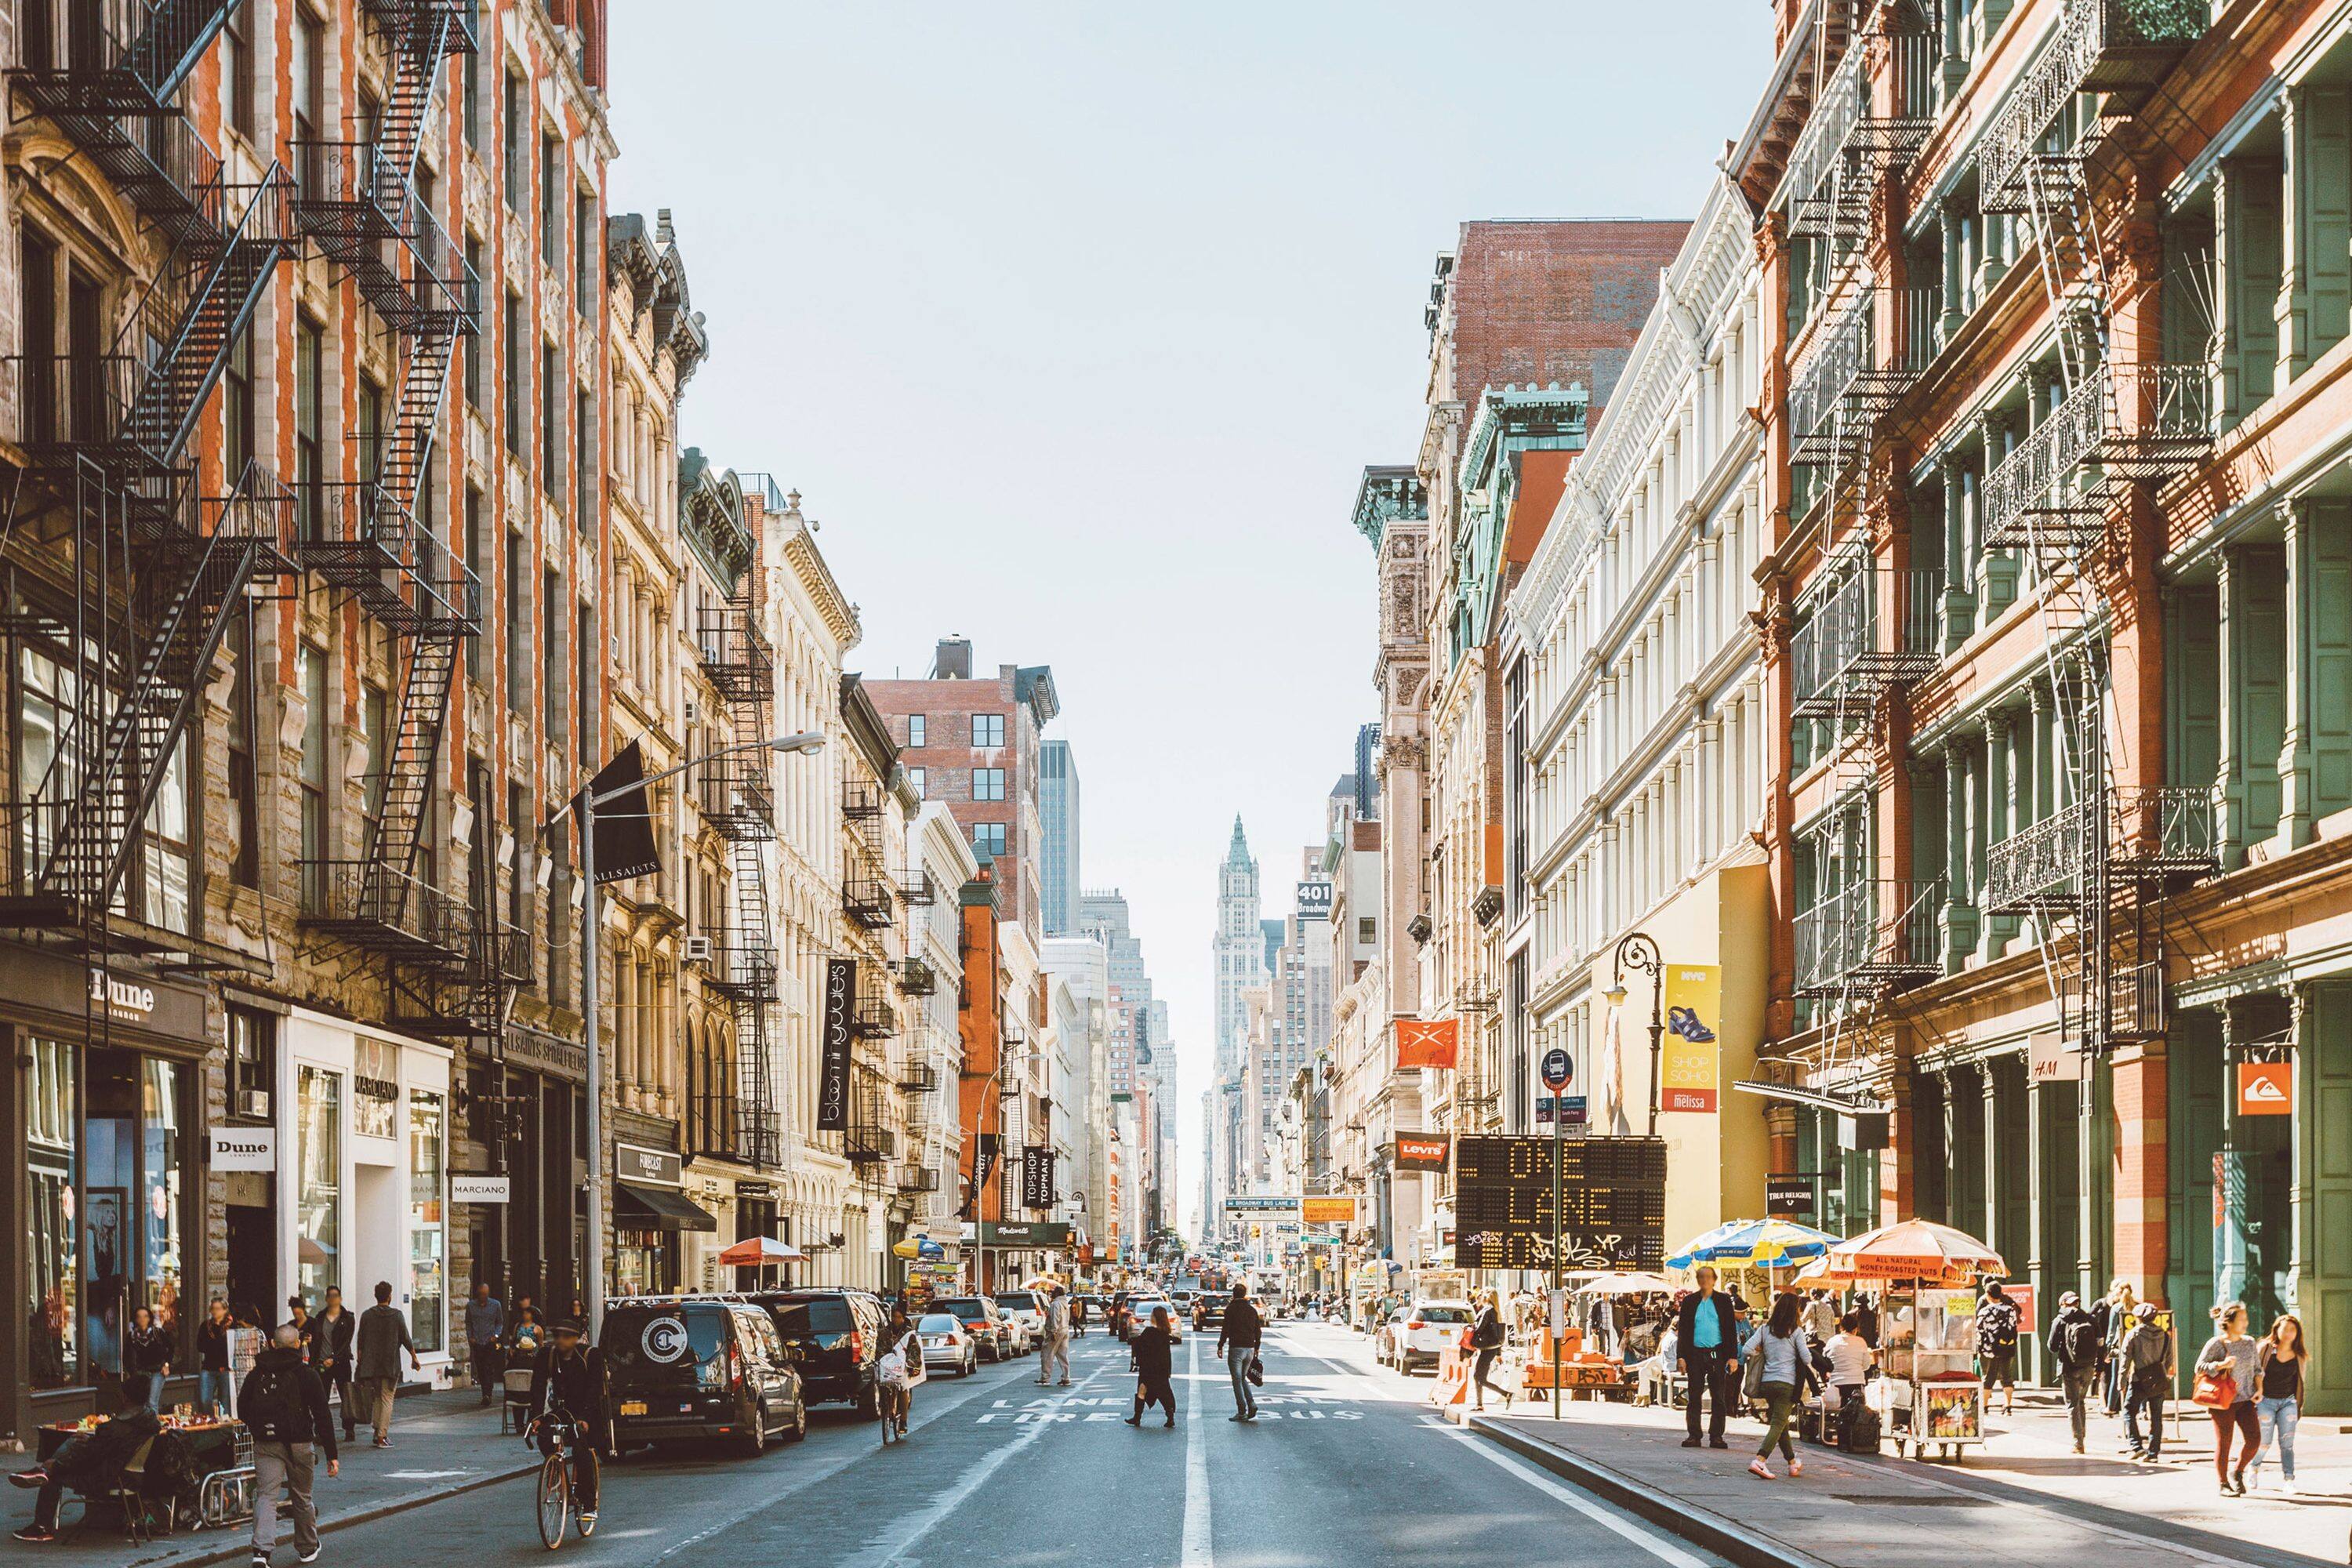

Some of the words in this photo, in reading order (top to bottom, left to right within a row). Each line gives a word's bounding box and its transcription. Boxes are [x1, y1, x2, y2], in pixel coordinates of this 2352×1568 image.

[1298, 886, 1330, 900] 401
[1298, 903, 1331, 913] Broadway
[1680, 971, 1706, 982] NYC
[89, 967, 154, 1012] Dune
[504, 1031, 541, 1059] LLSAINTS
[1671, 1056, 1709, 1069] SHOP
[2034, 1060, 2057, 1076] H&M
[1671, 1069, 1710, 1083] SOHO
[354, 1075, 399, 1100] MARCIANO
[1537, 1099, 1547, 1109] M5
[1537, 1112, 1547, 1121] M5
[216, 1142, 268, 1153] Dune
[1510, 1142, 1585, 1179] ONE
[1027, 1152, 1037, 1201] TOPSHOP
[1040, 1158, 1049, 1203] TOPMAN
[1769, 1192, 1784, 1201] TRUE
[1509, 1187, 1612, 1225] LANE
[997, 1226, 1029, 1235] Madewell
[1860, 1263, 1883, 1272] HONEY
[1885, 1265, 1917, 1274] ROASTED
[991, 1398, 1131, 1409] LANE
[975, 1412, 1121, 1424] FIRE
[1248, 1410, 1367, 1421] BUS
